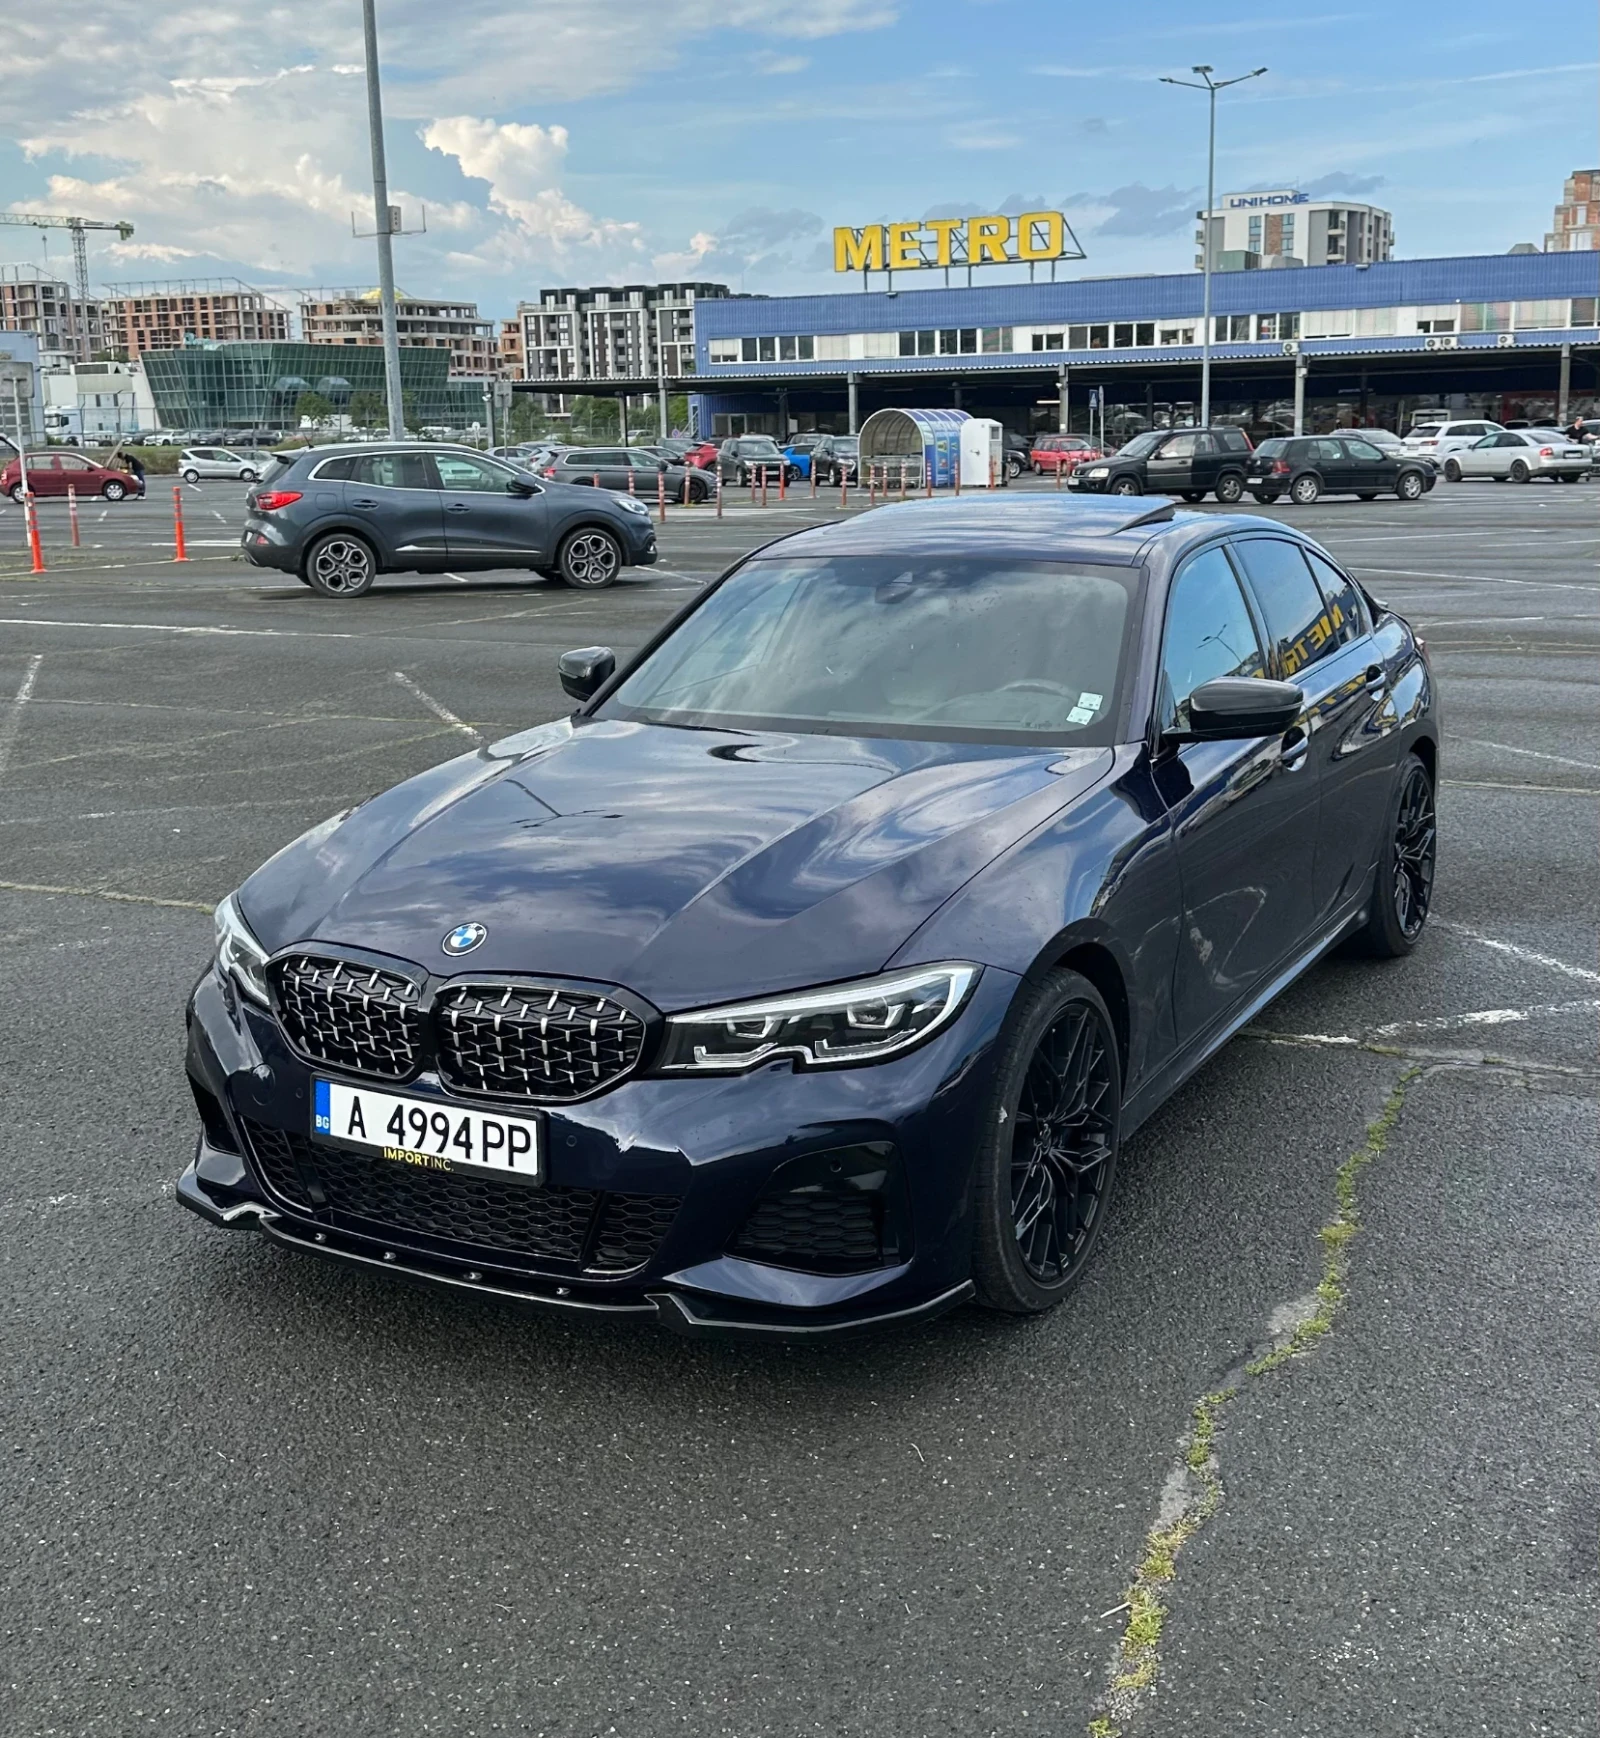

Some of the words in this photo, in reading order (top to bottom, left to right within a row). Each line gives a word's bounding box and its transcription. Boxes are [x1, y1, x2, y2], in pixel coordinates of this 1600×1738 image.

[1230, 193, 1309, 208] UNIHOME
[833, 211, 1064, 272] METRO
[315, 1114, 329, 1129] BG
